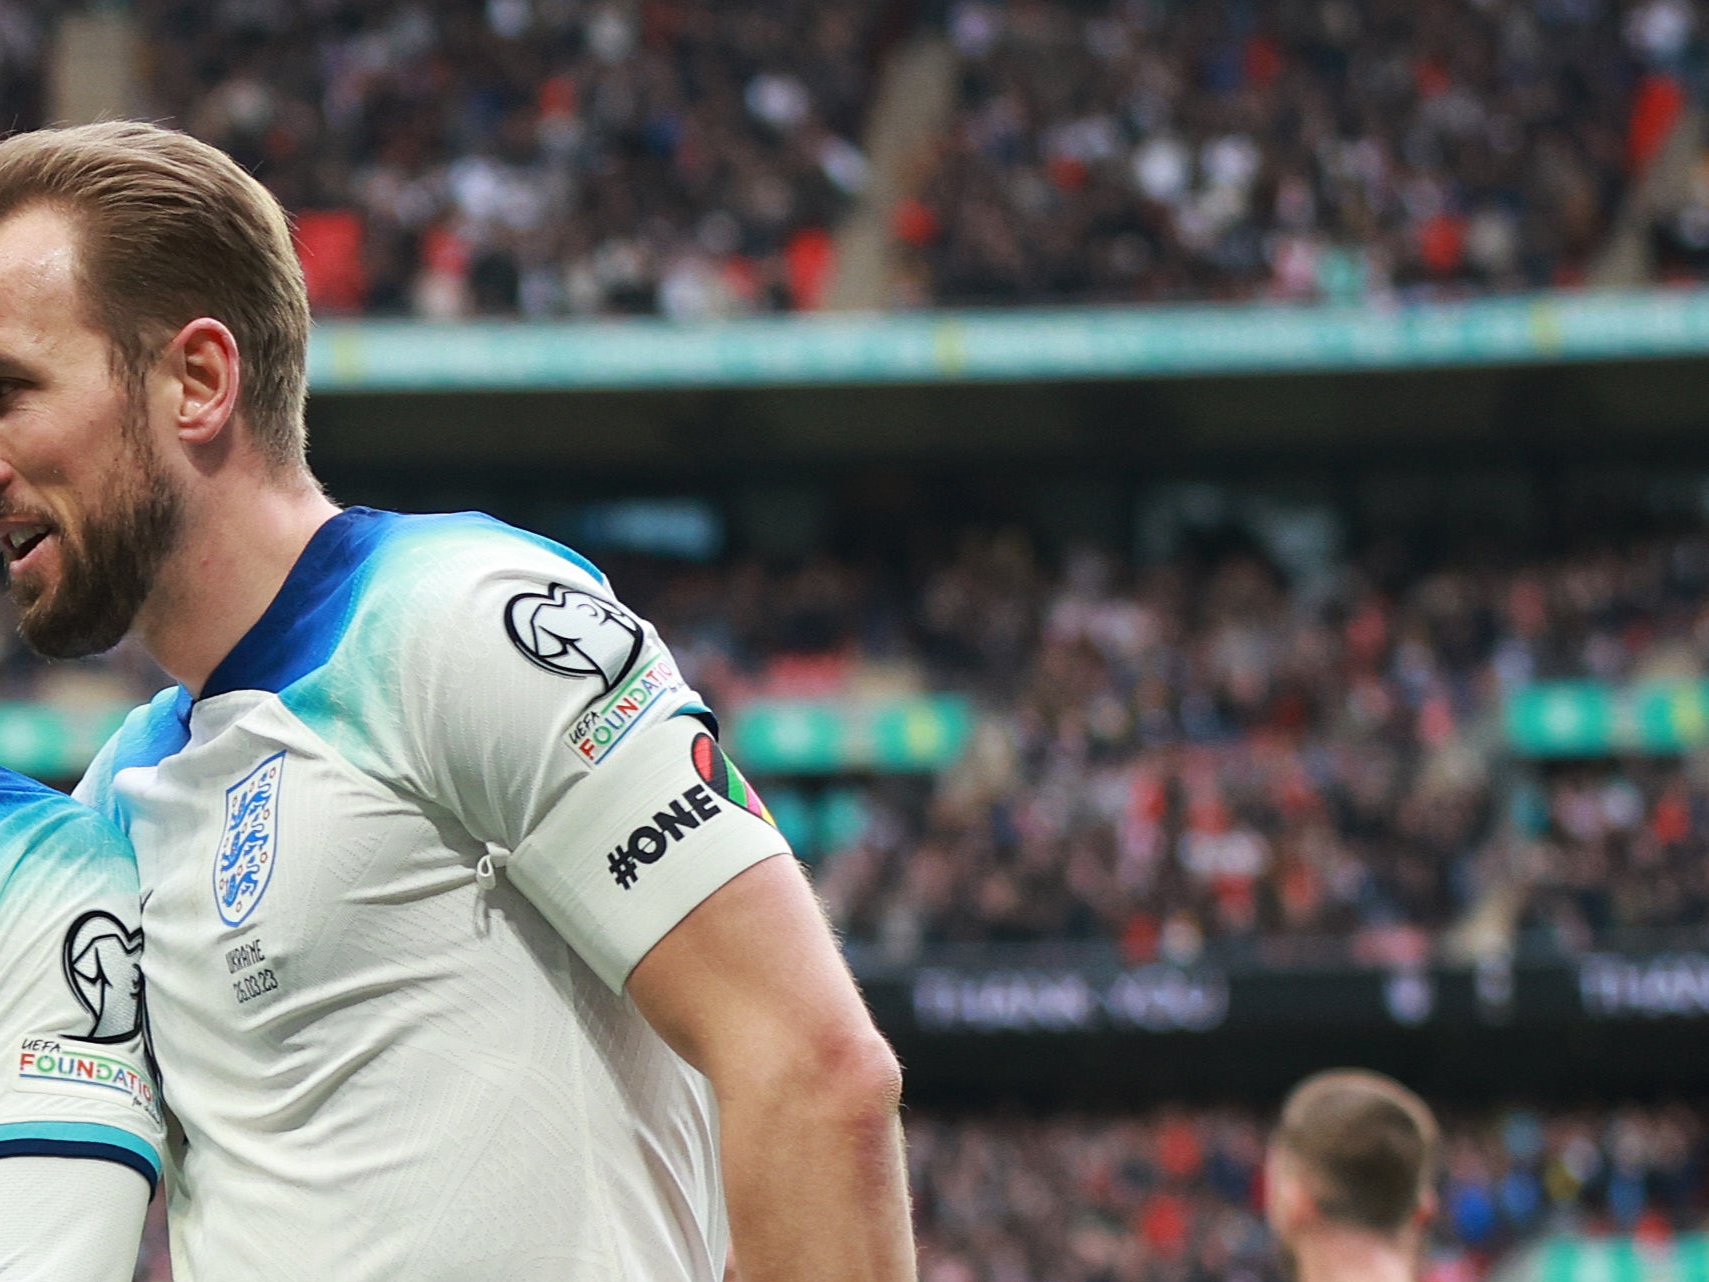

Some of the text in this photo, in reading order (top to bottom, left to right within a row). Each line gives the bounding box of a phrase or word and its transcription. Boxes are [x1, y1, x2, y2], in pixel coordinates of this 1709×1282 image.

[569, 711, 600, 744] UEFA
[579, 661, 674, 760] FOUNDATIO
[606, 784, 722, 890] #ONE
[21, 1038, 62, 1053] UEFA
[19, 1053, 154, 1102] FOUNDATIO
